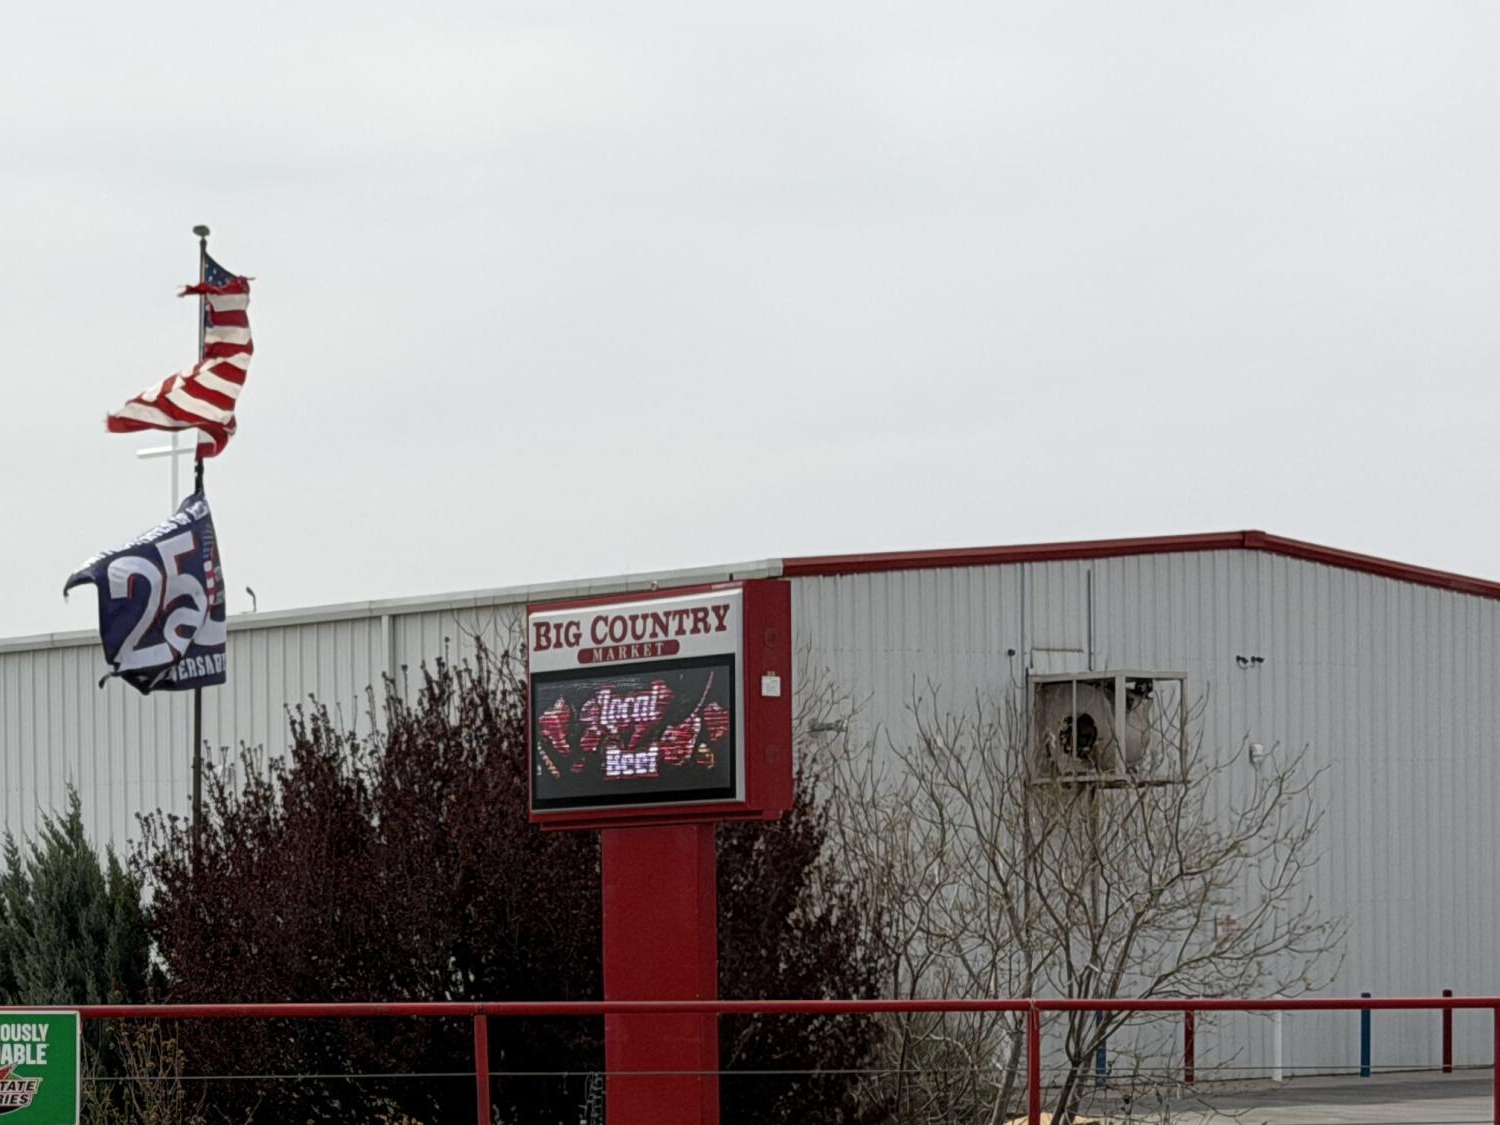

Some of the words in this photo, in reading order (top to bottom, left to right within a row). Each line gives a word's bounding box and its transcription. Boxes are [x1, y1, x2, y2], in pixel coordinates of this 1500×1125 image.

[533, 621, 582, 652] BIG
[590, 604, 730, 644] COUNTRY
[592, 642, 665, 663] MARKET
[606, 746, 658, 776] Beef
